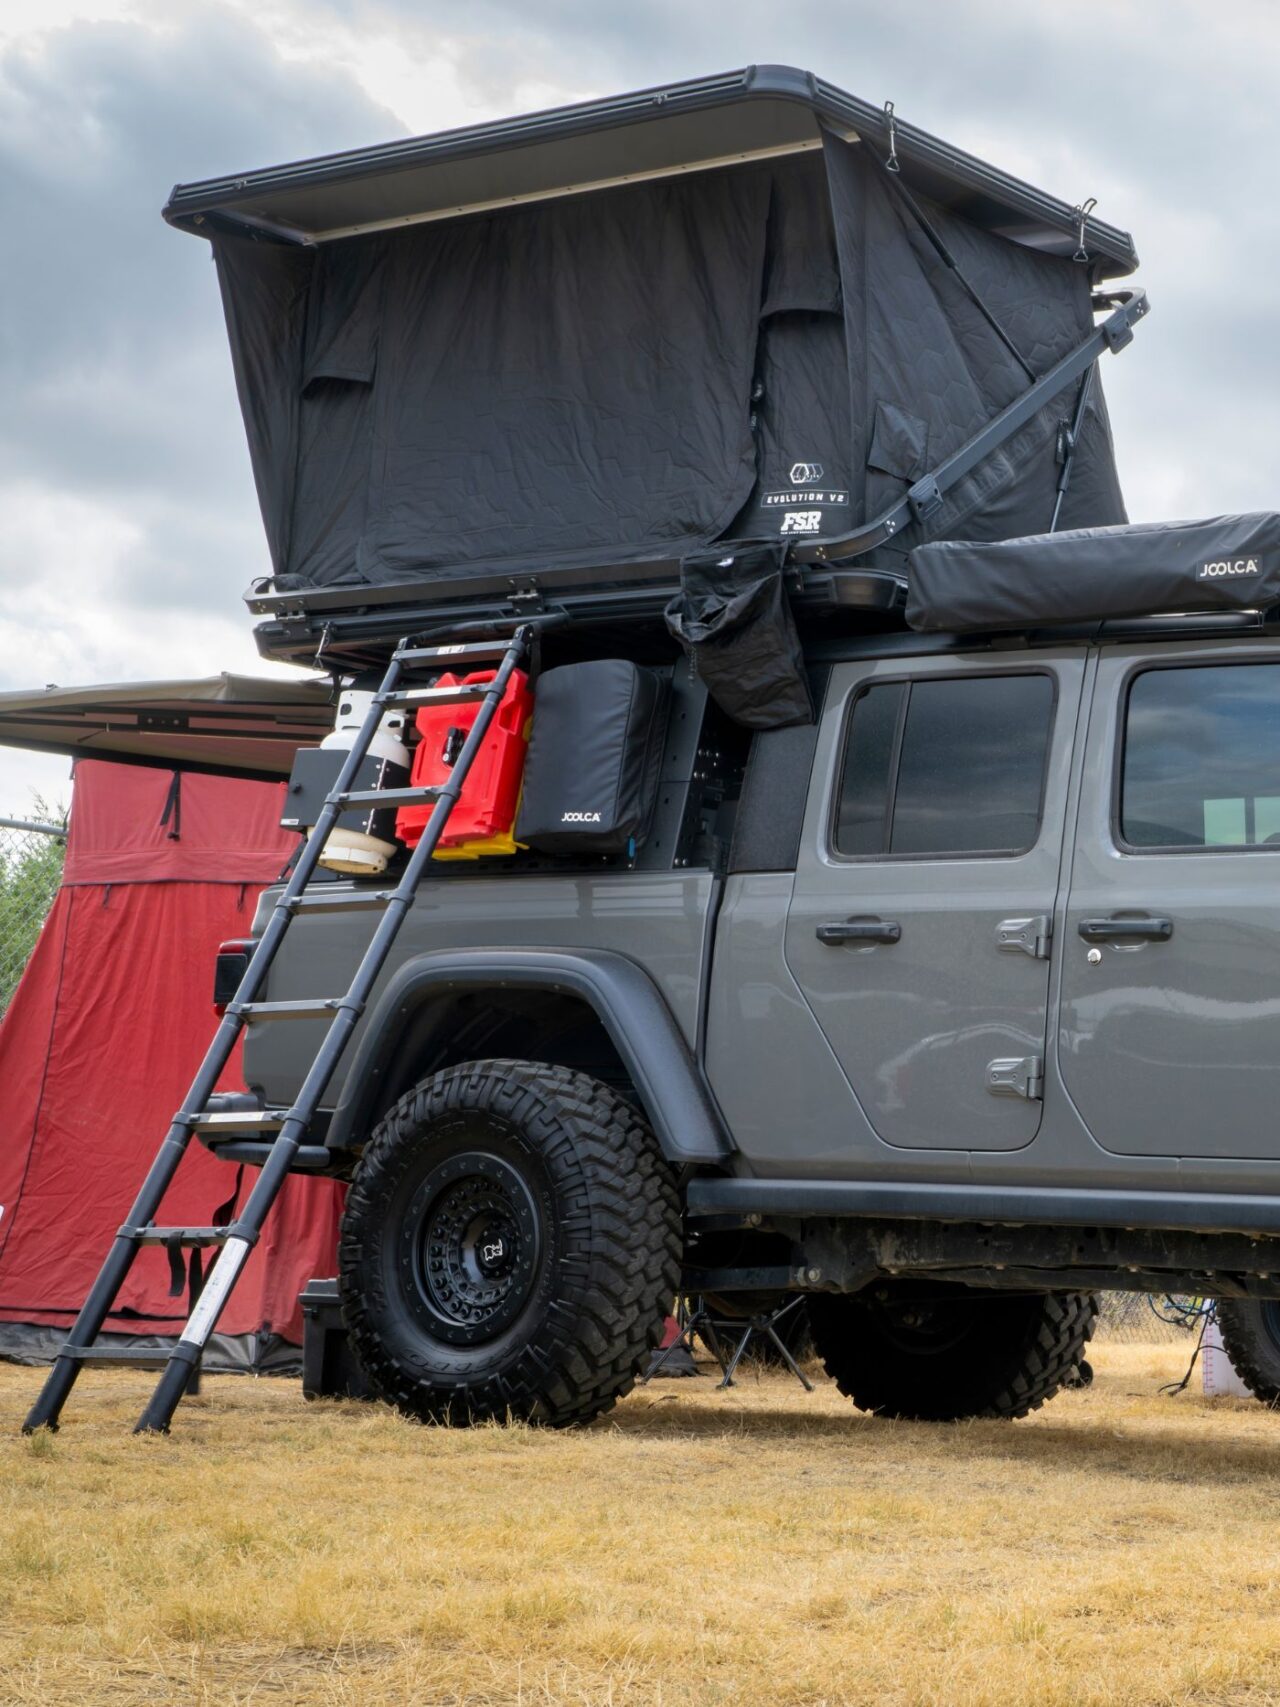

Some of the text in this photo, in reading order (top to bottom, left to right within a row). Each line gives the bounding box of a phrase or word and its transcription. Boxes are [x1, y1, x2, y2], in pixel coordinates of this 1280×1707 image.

[766, 493, 845, 504] EVOLUTION V2
[780, 511, 822, 531] FSR
[1200, 559, 1258, 577] JOOLCA
[561, 812, 601, 822] JOOLCA
